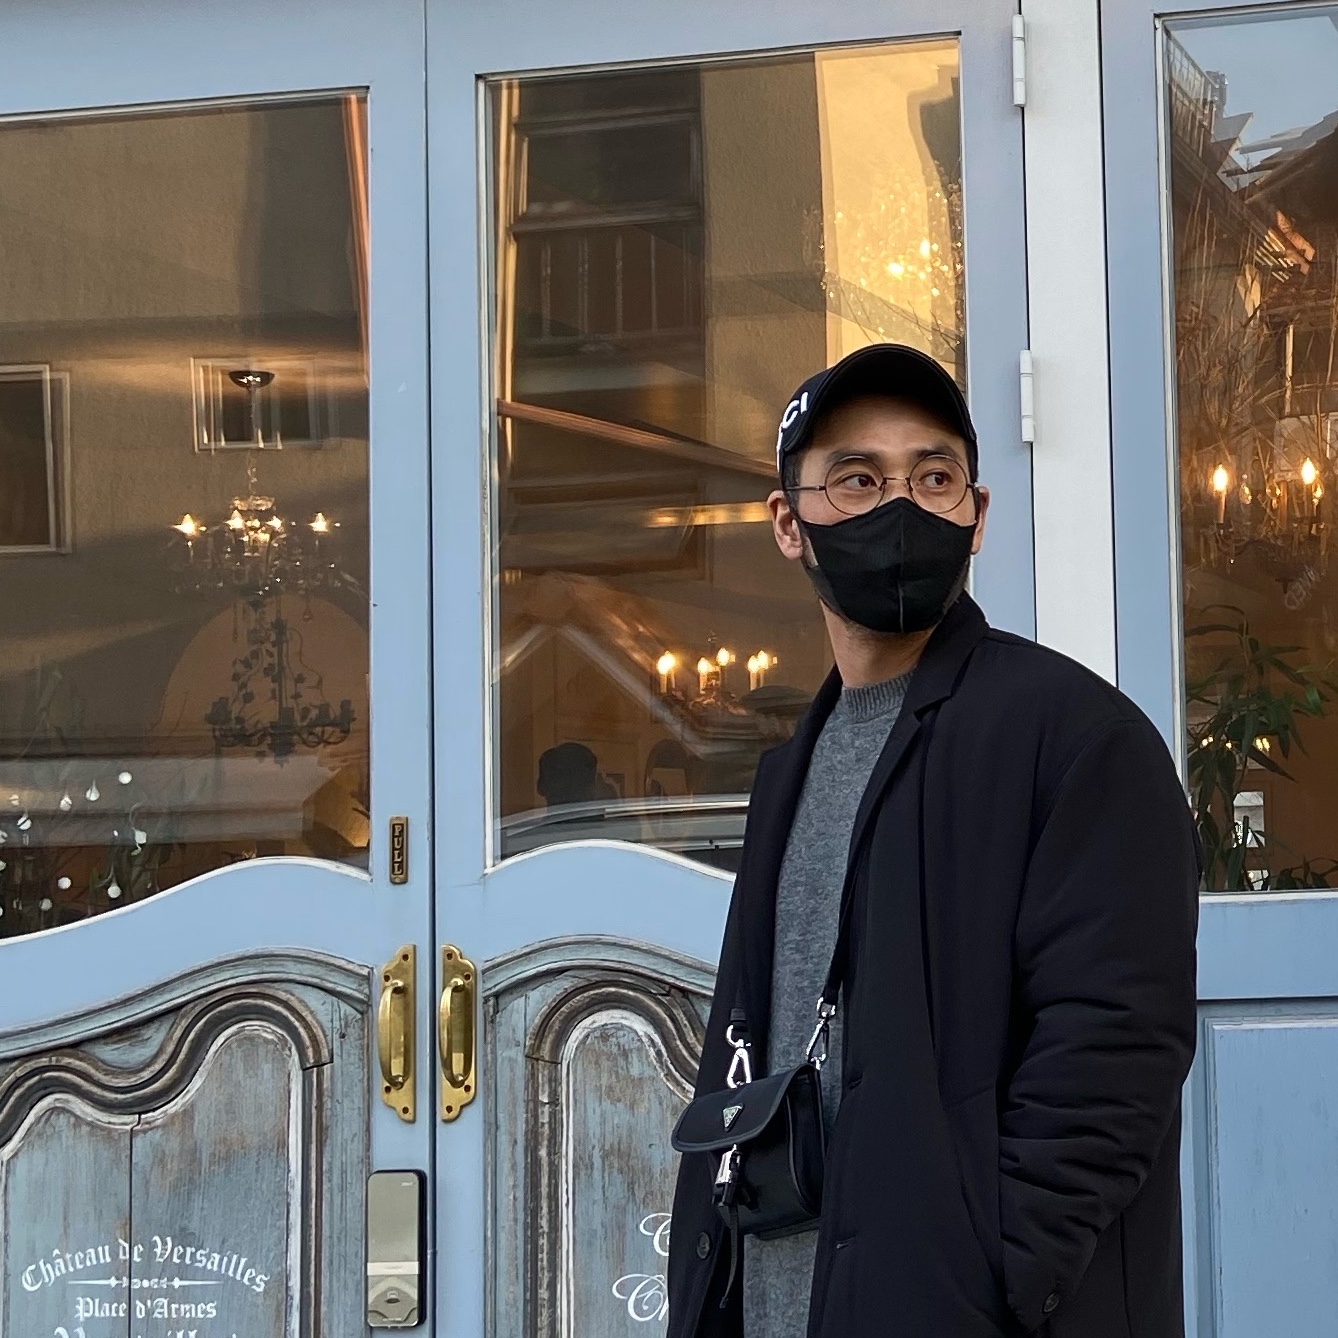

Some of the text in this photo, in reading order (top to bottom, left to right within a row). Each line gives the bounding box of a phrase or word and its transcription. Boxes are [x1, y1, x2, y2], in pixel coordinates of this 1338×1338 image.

[393, 824, 403, 875] PULL
[21, 1235, 270, 1293] Château de Versailles
[75, 1297, 217, 1321] Place d'Armes
